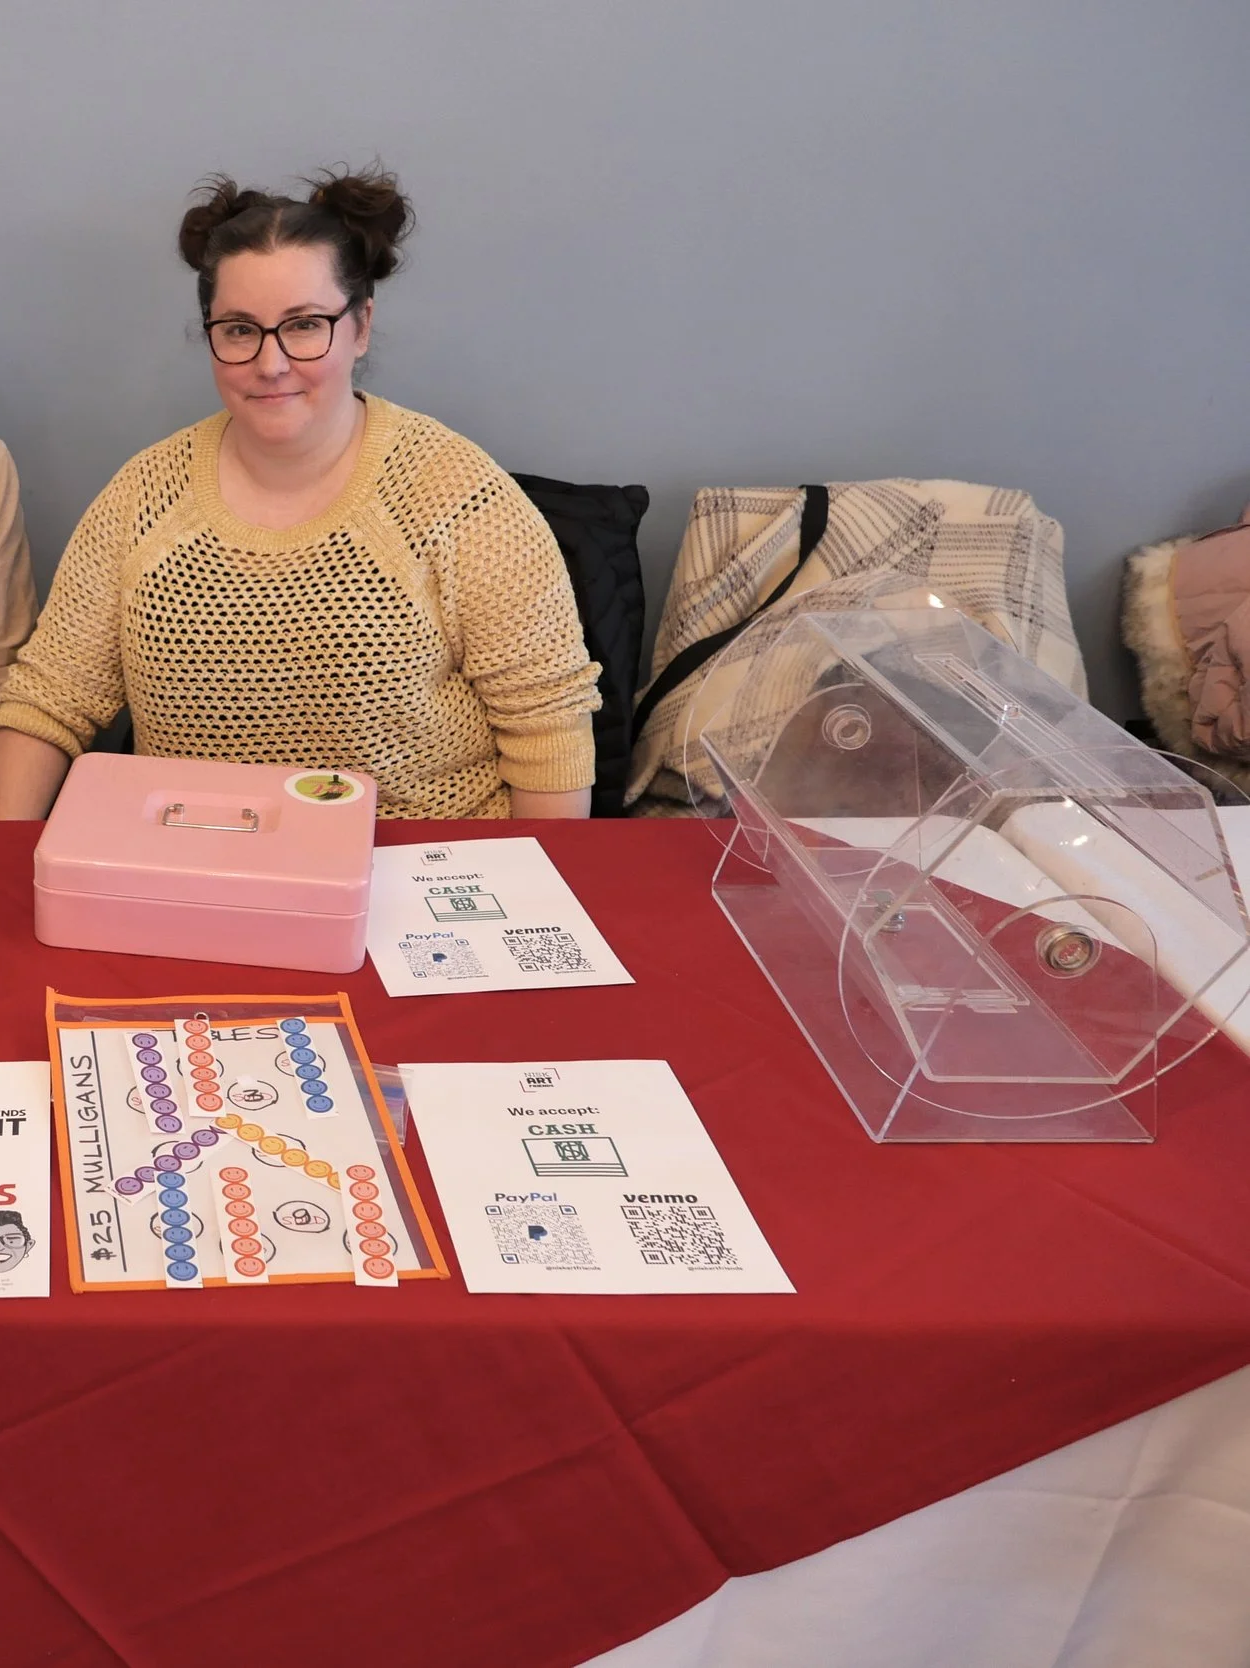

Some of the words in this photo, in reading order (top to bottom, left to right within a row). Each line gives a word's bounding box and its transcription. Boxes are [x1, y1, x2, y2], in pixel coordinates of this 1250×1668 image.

[412, 875, 433, 883] We
[436, 872, 485, 883] accept:
[428, 884, 484, 895] CASH
[405, 932, 454, 941] PayPal
[504, 926, 562, 936] venmo
[151, 1027, 279, 1042] TBLES
[526, 1077, 553, 1085] ART
[508, 1107, 535, 1117] We
[538, 1105, 600, 1118] accept:
[69, 1054, 109, 1194] MULLIGANS
[528, 1123, 599, 1136] CASH
[494, 1192, 558, 1204] PayPal
[623, 1193, 698, 1204] venmo
[89, 1209, 117, 1262] $25
